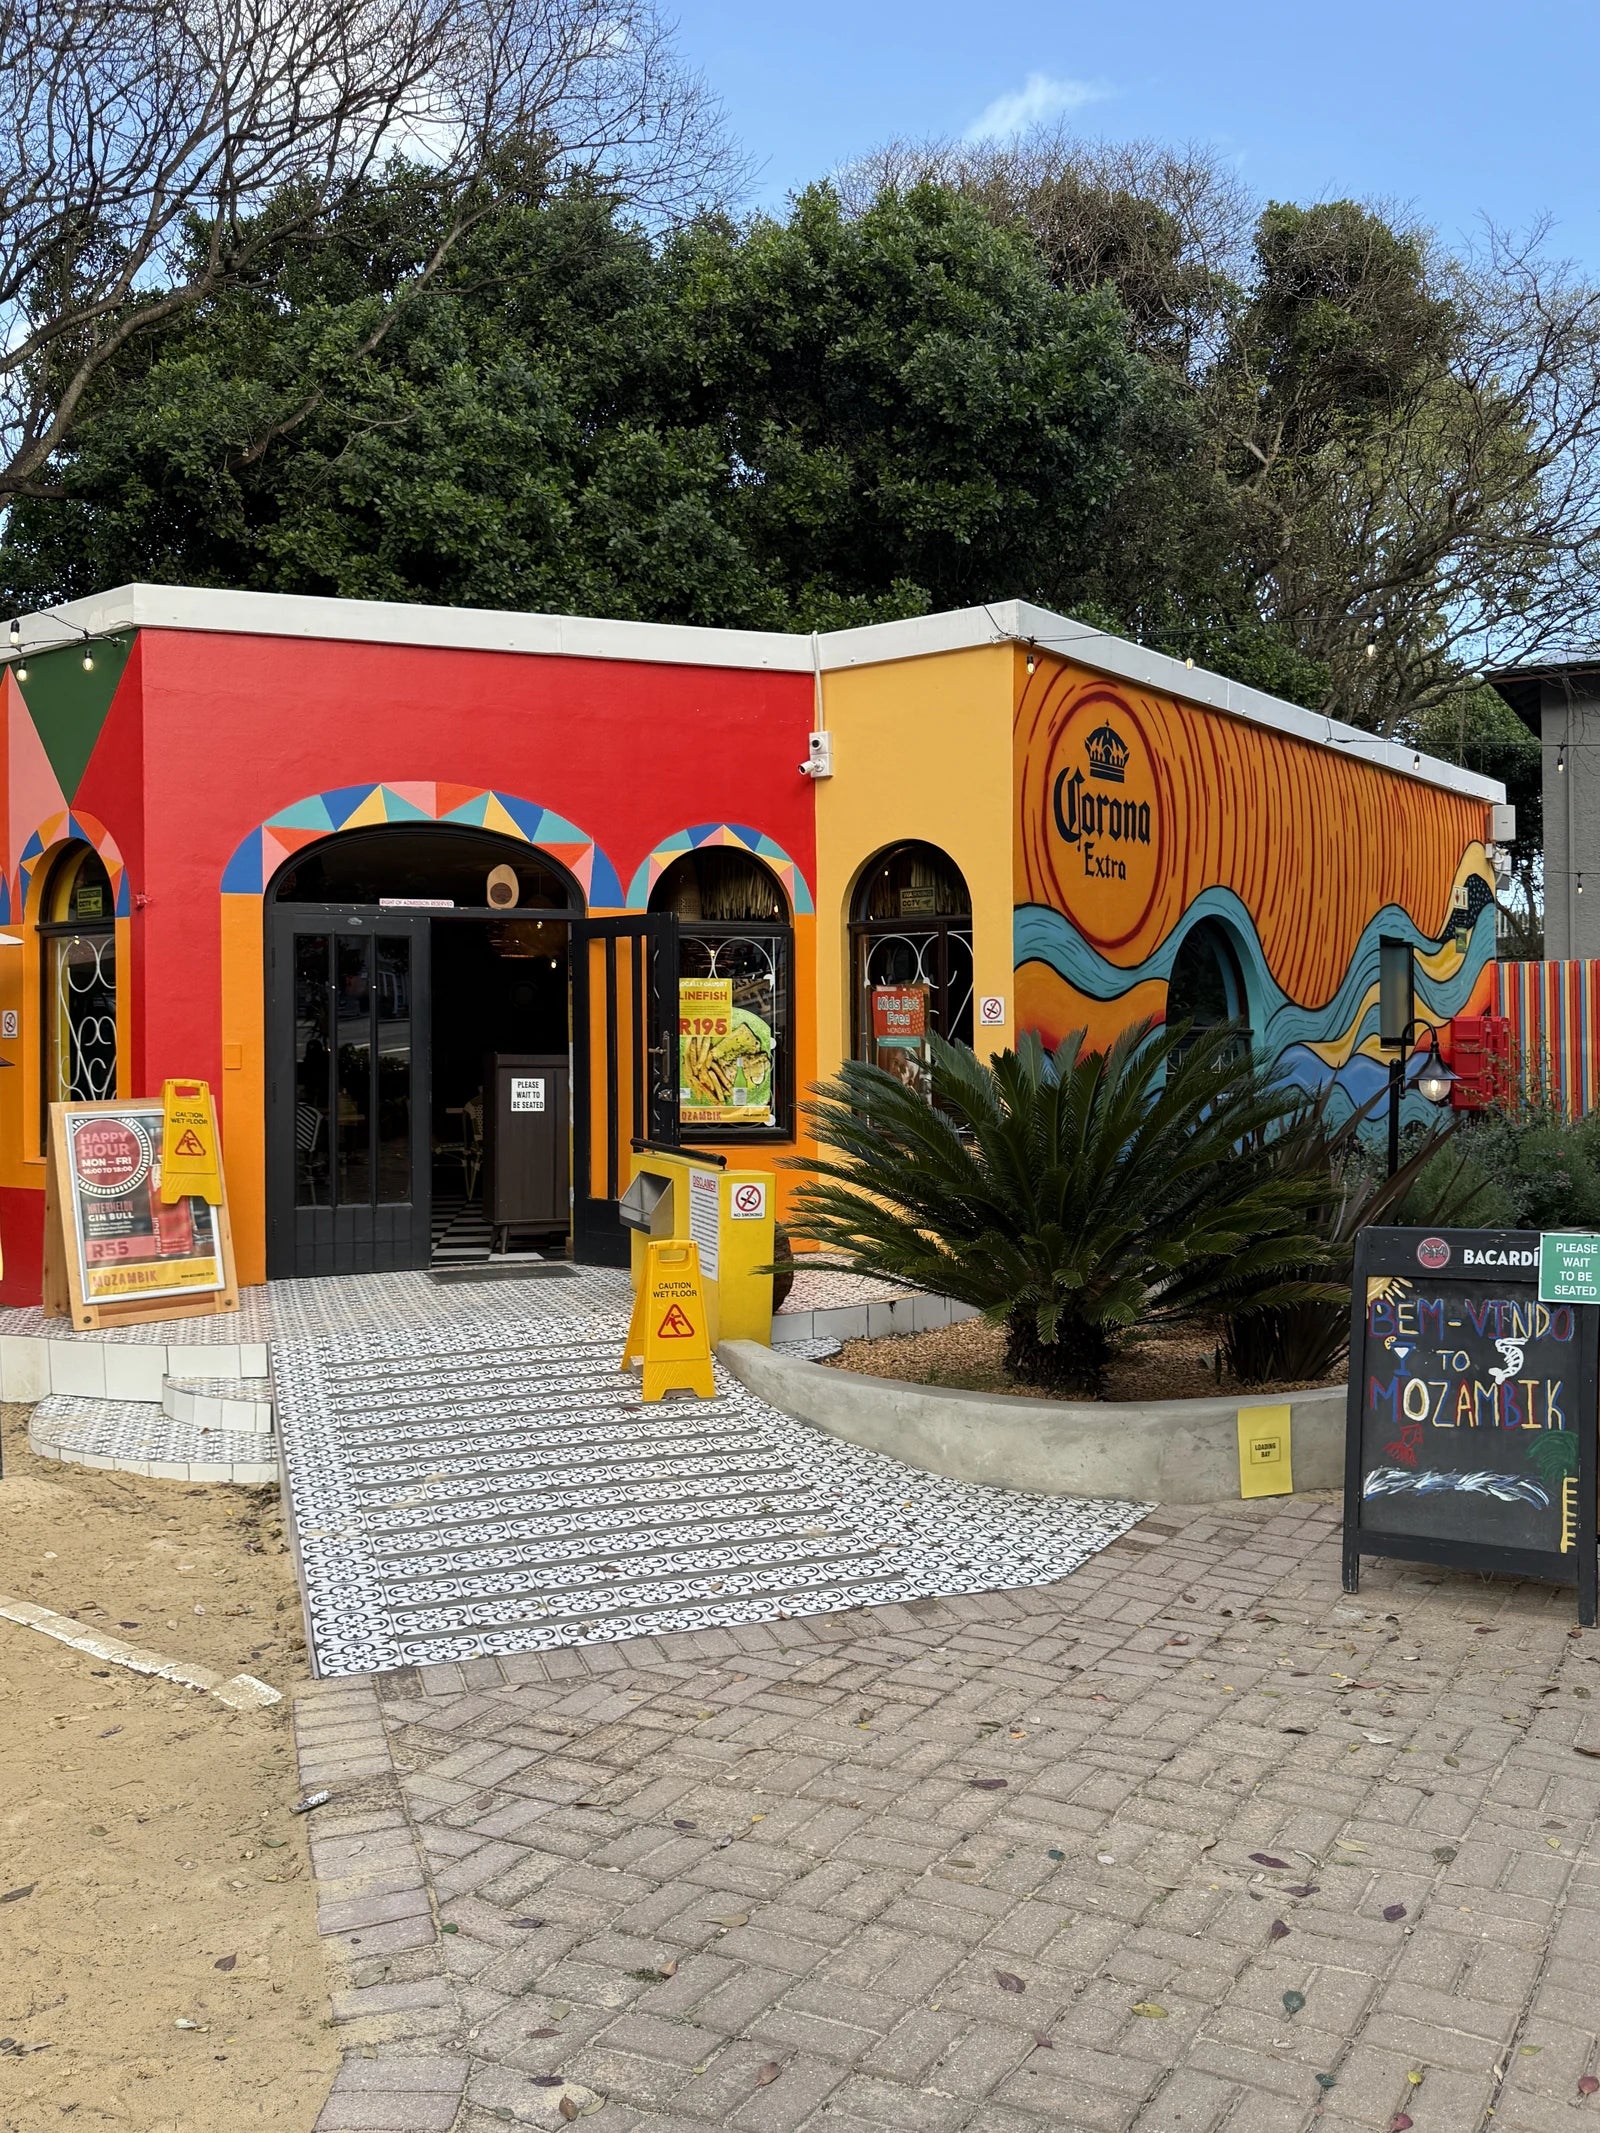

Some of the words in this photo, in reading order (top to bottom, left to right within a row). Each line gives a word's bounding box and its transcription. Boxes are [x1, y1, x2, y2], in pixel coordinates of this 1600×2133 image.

[1053, 766, 1151, 852] Corona
[1084, 841, 1126, 880] Extra
[877, 995, 901, 1010] Kids
[902, 996, 920, 1010] Eat
[887, 1011, 911, 1025] Free
[679, 1018, 728, 1035] R195
[517, 1081, 539, 1089] PLEASE
[681, 1111, 722, 1120] OZAMBIK
[80, 1131, 129, 1145] HAPPY
[81, 1143, 130, 1157] HOUR
[82, 1158, 106, 1167] MON
[116, 1156, 132, 1165] FRI
[111, 1212, 134, 1220] BULL
[92, 1241, 129, 1258] R55
[1556, 1243, 1598, 1253] PLEASE
[1463, 1246, 1540, 1266] BACARDÍ
[1563, 1257, 1590, 1267] WAIT
[93, 1270, 158, 1288] MOZAMBIK
[1560, 1271, 1574, 1281] TO
[1577, 1272, 1592, 1281] BE
[1554, 1285, 1597, 1296] SEATED
[1436, 1350, 1470, 1372] TO
[1369, 1376, 1566, 1430] MOZAMBIK
[1255, 1442, 1276, 1450] LOADING
